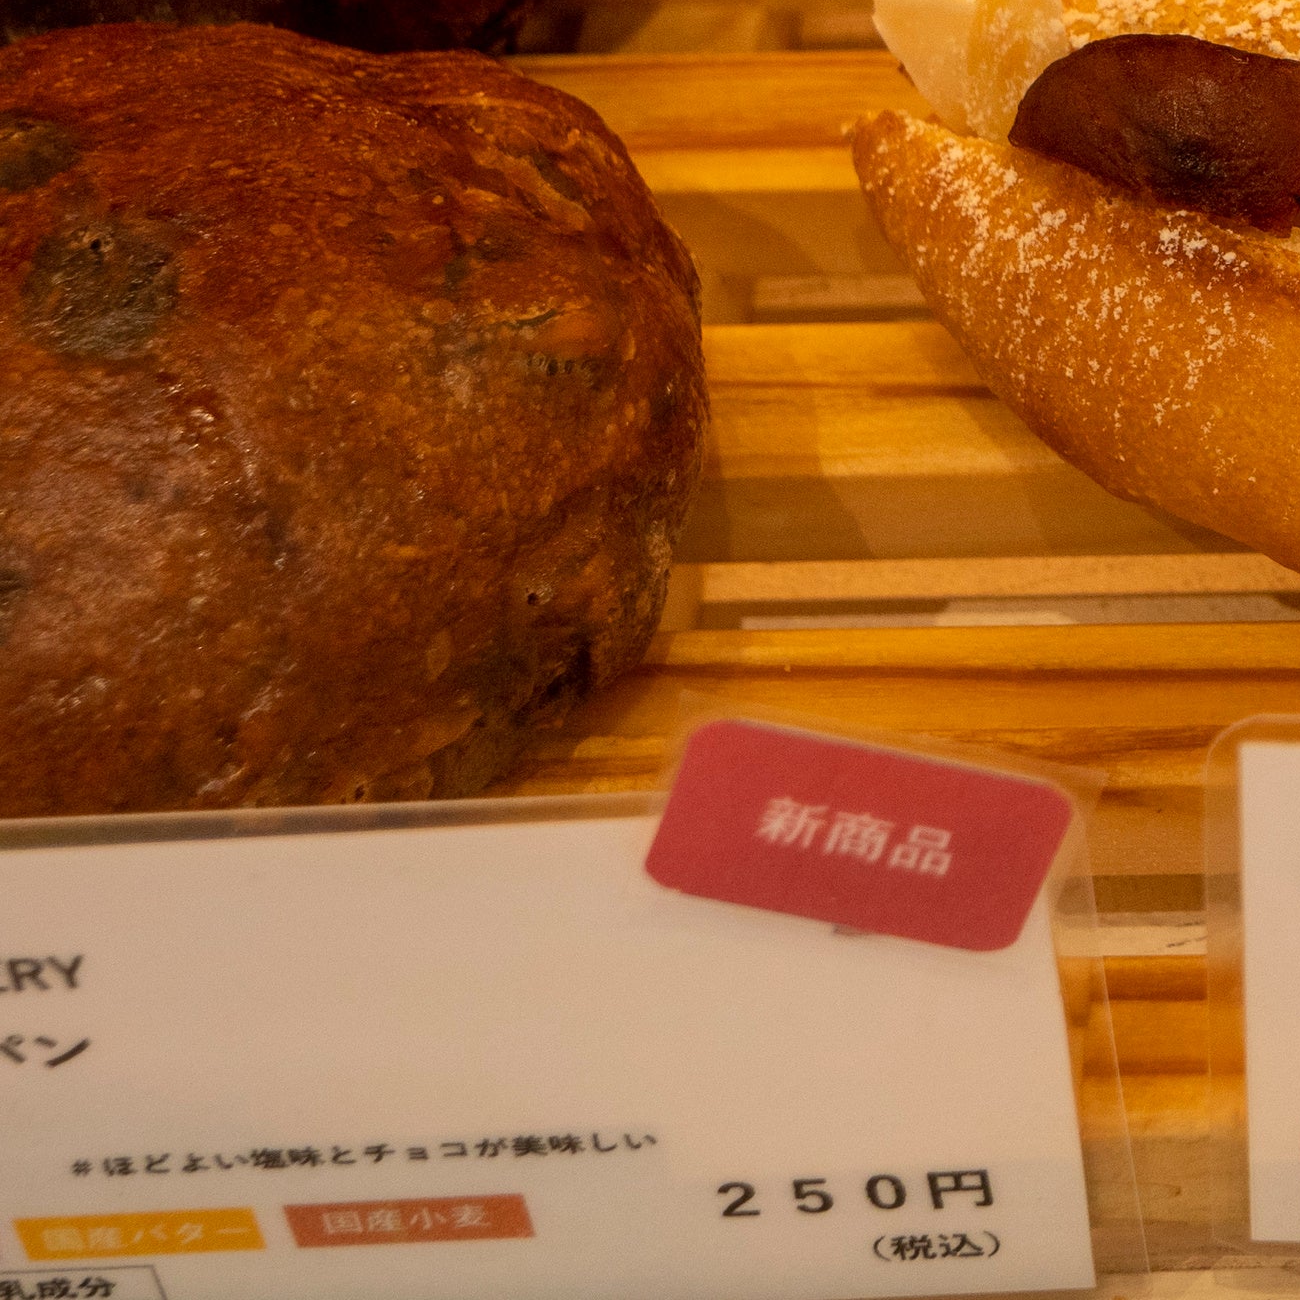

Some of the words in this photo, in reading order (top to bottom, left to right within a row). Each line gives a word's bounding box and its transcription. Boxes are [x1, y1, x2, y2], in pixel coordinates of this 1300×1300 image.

[755, 796, 954, 877] 新商品
[0, 954, 83, 992] RY
[71, 1132, 659, 1177] #ほどよい塩味とチョコが美味しい
[42, 1222, 250, 1252] 国産バター
[321, 1206, 490, 1236] 国産小麦
[872, 1231, 1001, 1261] (税込)
